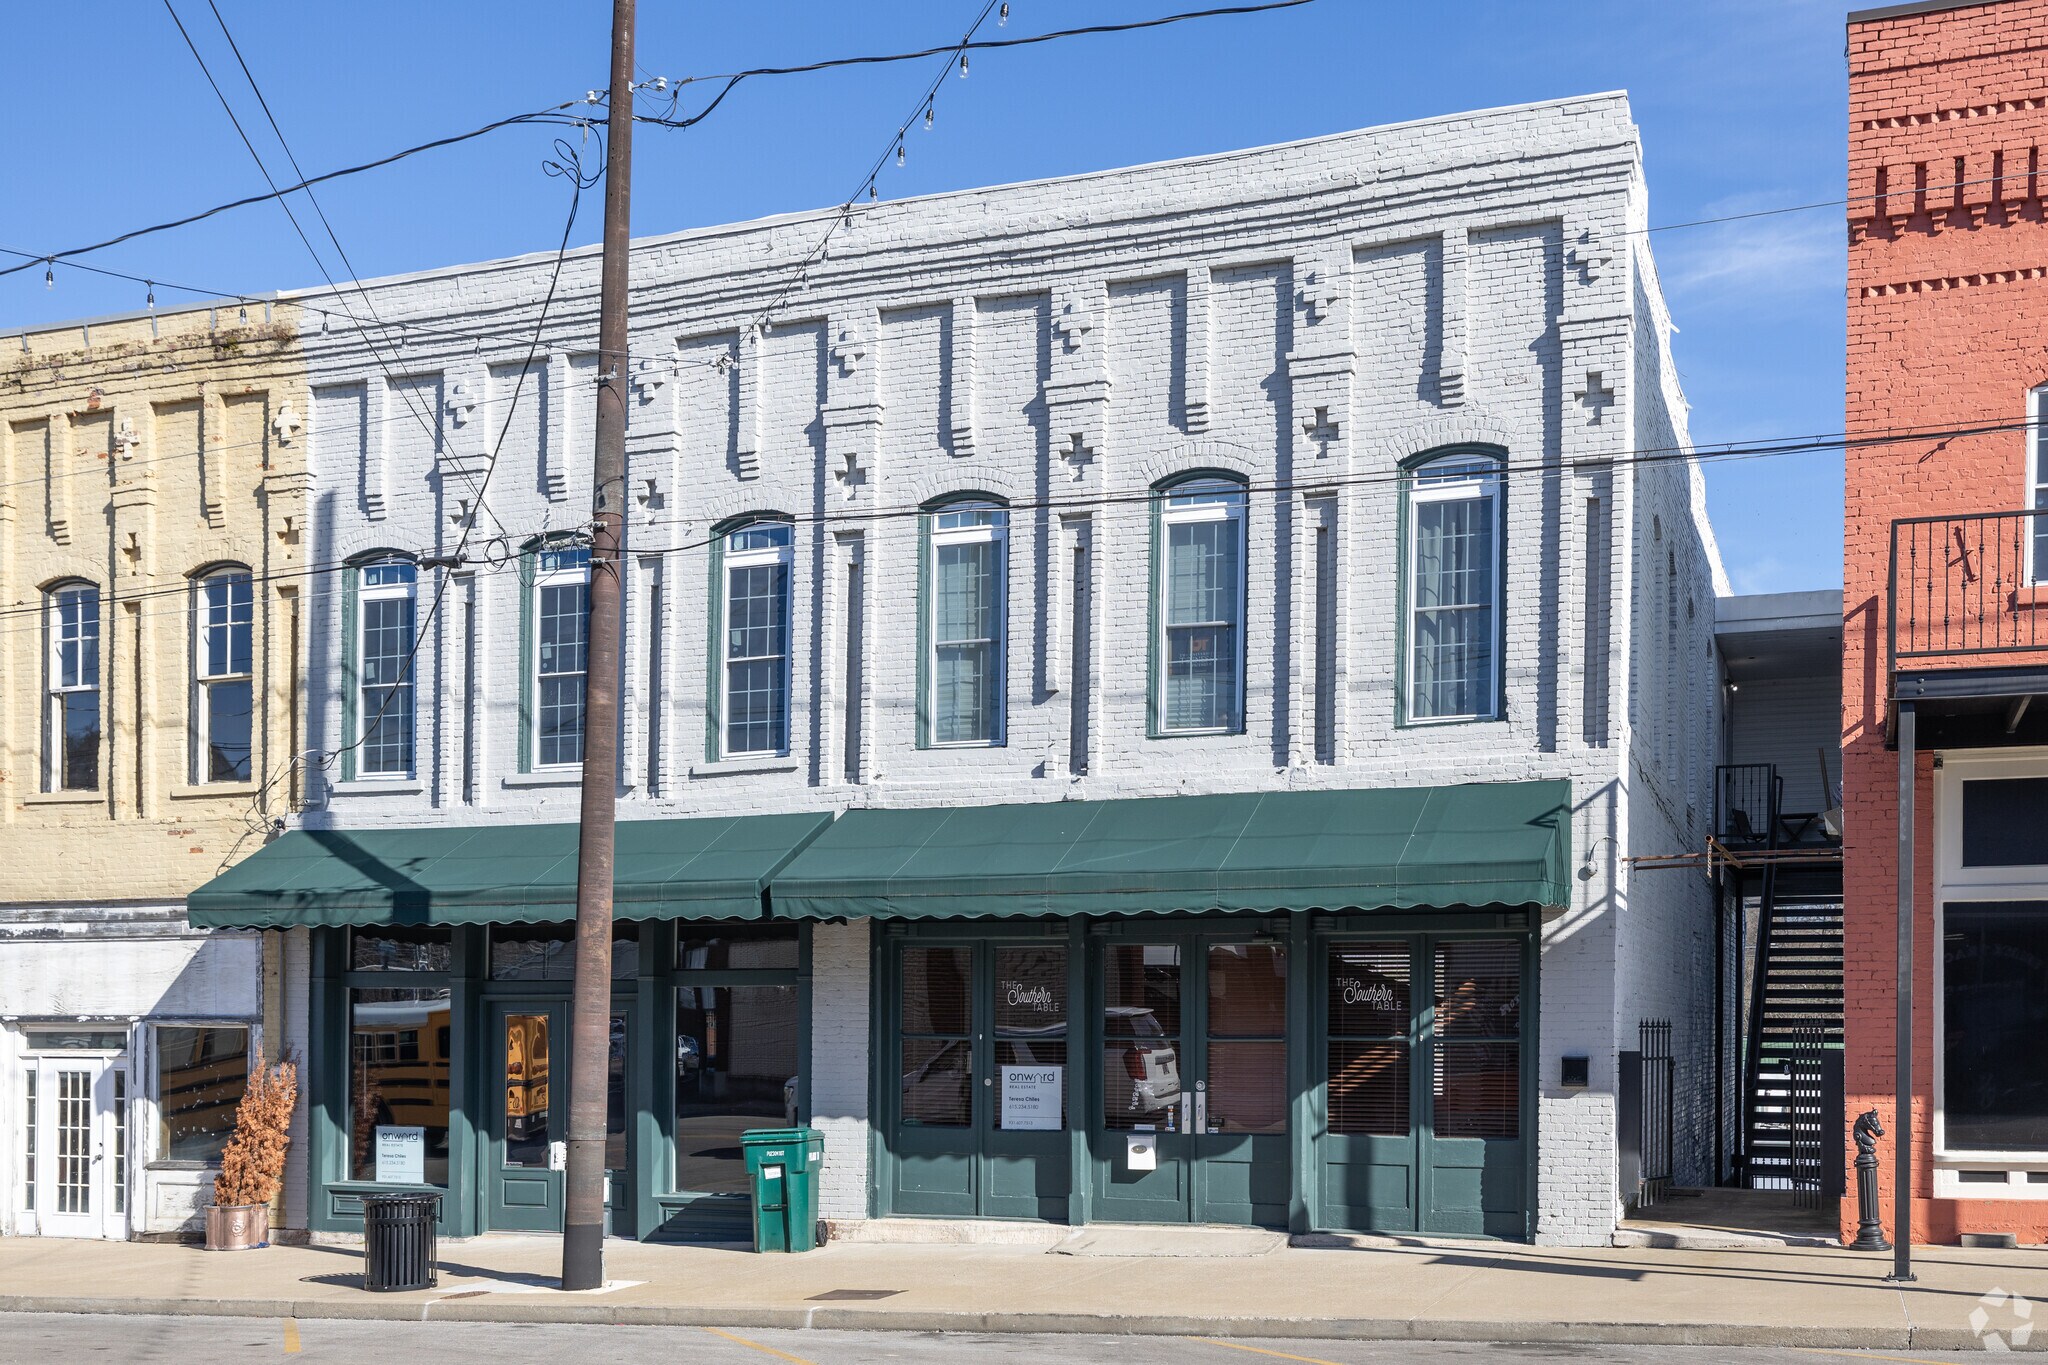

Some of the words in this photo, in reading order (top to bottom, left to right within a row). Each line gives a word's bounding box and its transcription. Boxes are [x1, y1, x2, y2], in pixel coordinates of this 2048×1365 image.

[1001, 981, 1017, 990] THE
[1337, 978, 1355, 987] THE
[1008, 984, 1052, 1006] Southern
[1344, 981, 1394, 1004] Southern
[1033, 1003, 1059, 1012] TABLE
[1371, 1001, 1402, 1011] TABLE
